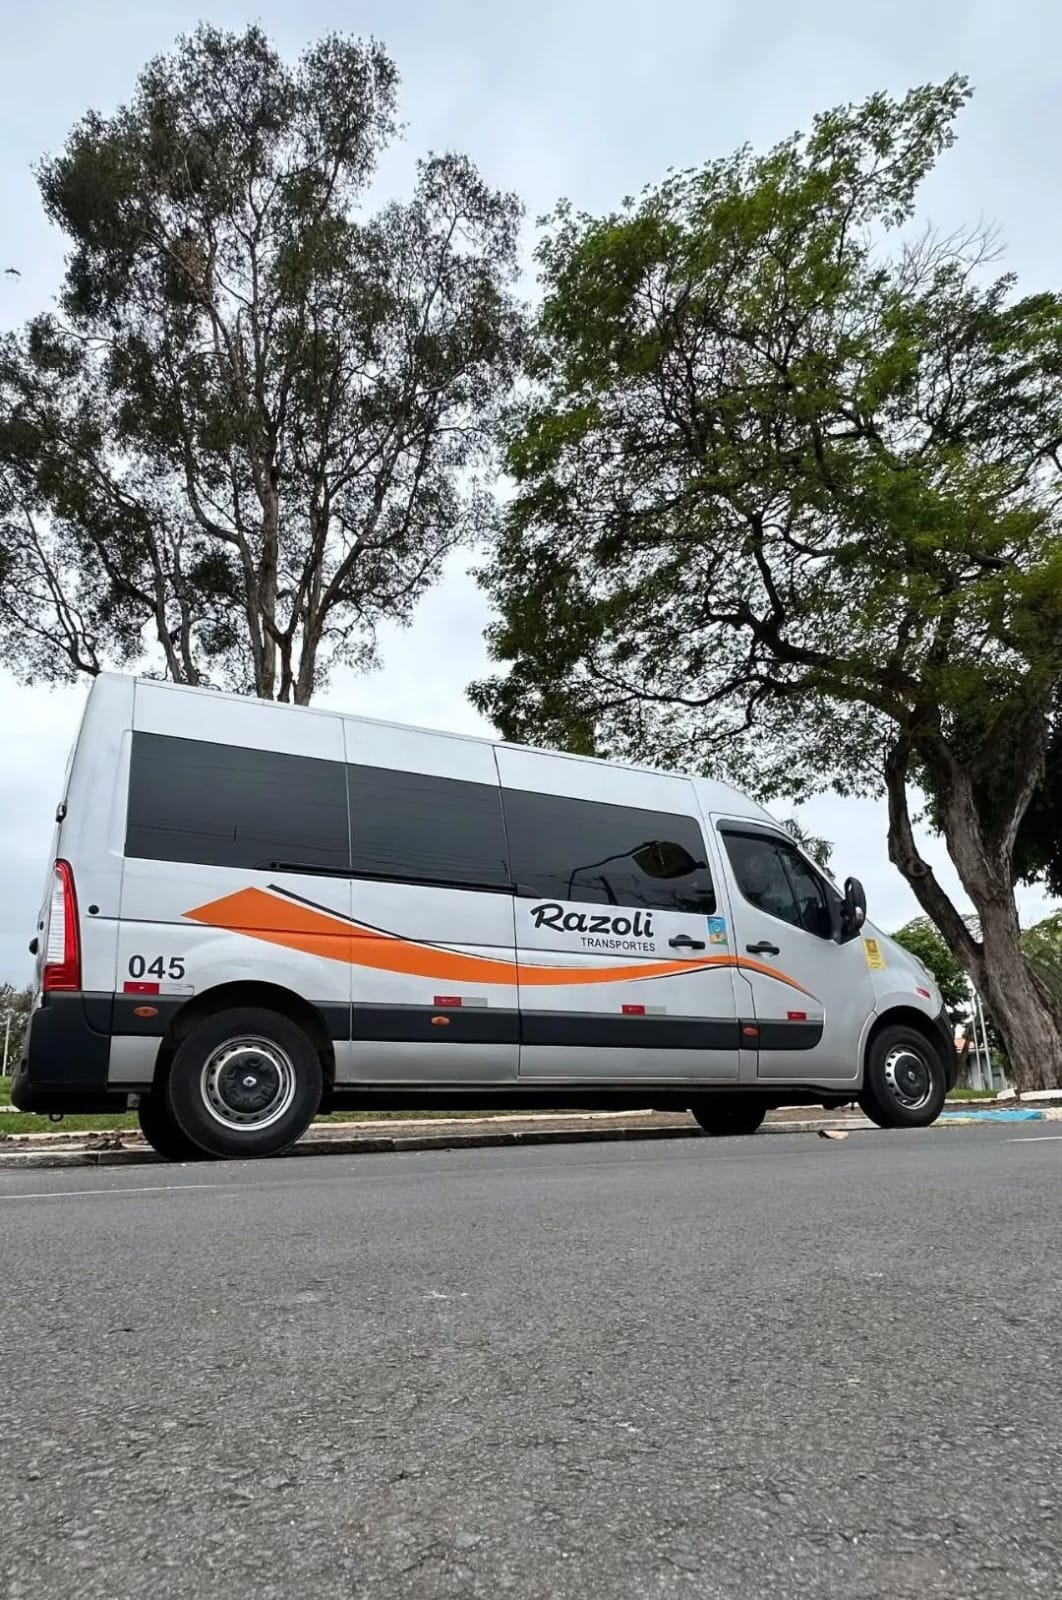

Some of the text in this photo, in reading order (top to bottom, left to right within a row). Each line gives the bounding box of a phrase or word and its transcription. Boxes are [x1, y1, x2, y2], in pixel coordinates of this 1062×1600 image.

[530, 903, 654, 938] Razoli
[581, 937, 656, 952] TRANSPORTES
[128, 955, 185, 980] 045
